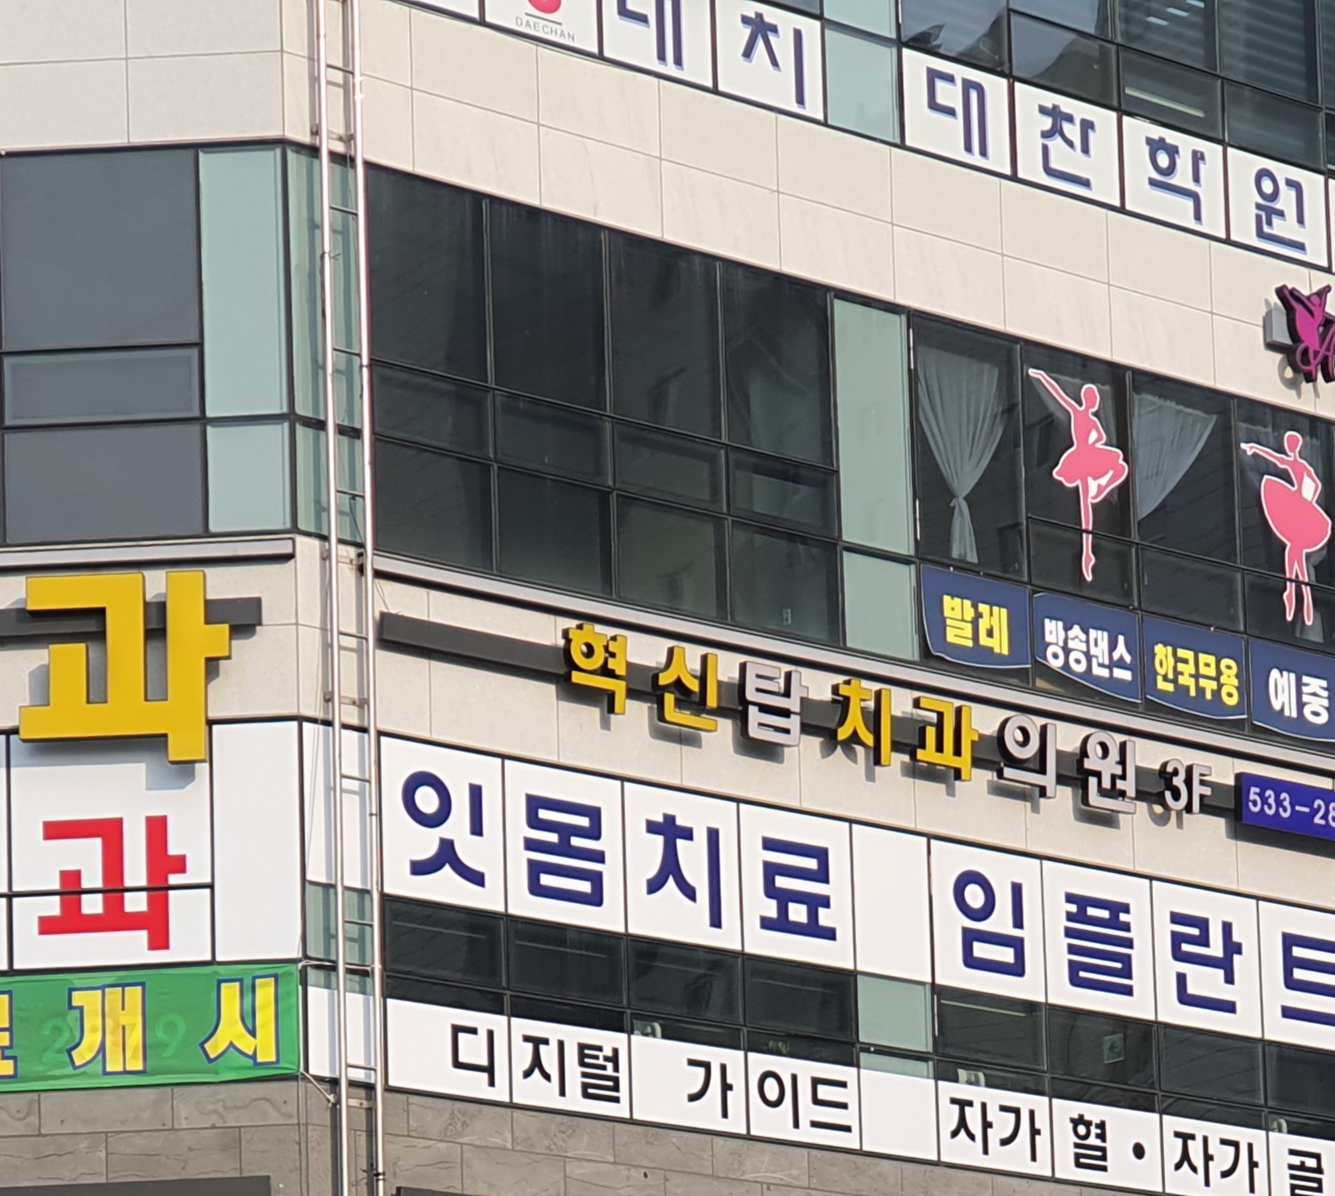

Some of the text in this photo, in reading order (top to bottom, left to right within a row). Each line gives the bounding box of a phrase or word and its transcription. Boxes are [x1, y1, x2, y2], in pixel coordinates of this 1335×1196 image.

[514, 15, 576, 43] DAECHAN
[926, 66, 1307, 254] 대찬학원
[942, 594, 1010, 656] 발레
[1044, 617, 1134, 682] 방송댄스
[1153, 649, 1240, 706] 한국무용
[1268, 669, 1331, 724] 예중
[1161, 758, 1213, 815] 3F
[401, 770, 838, 942] 잇몸치료
[449, 1023, 623, 1104] 디지털
[686, 1058, 853, 1133] 가이드
